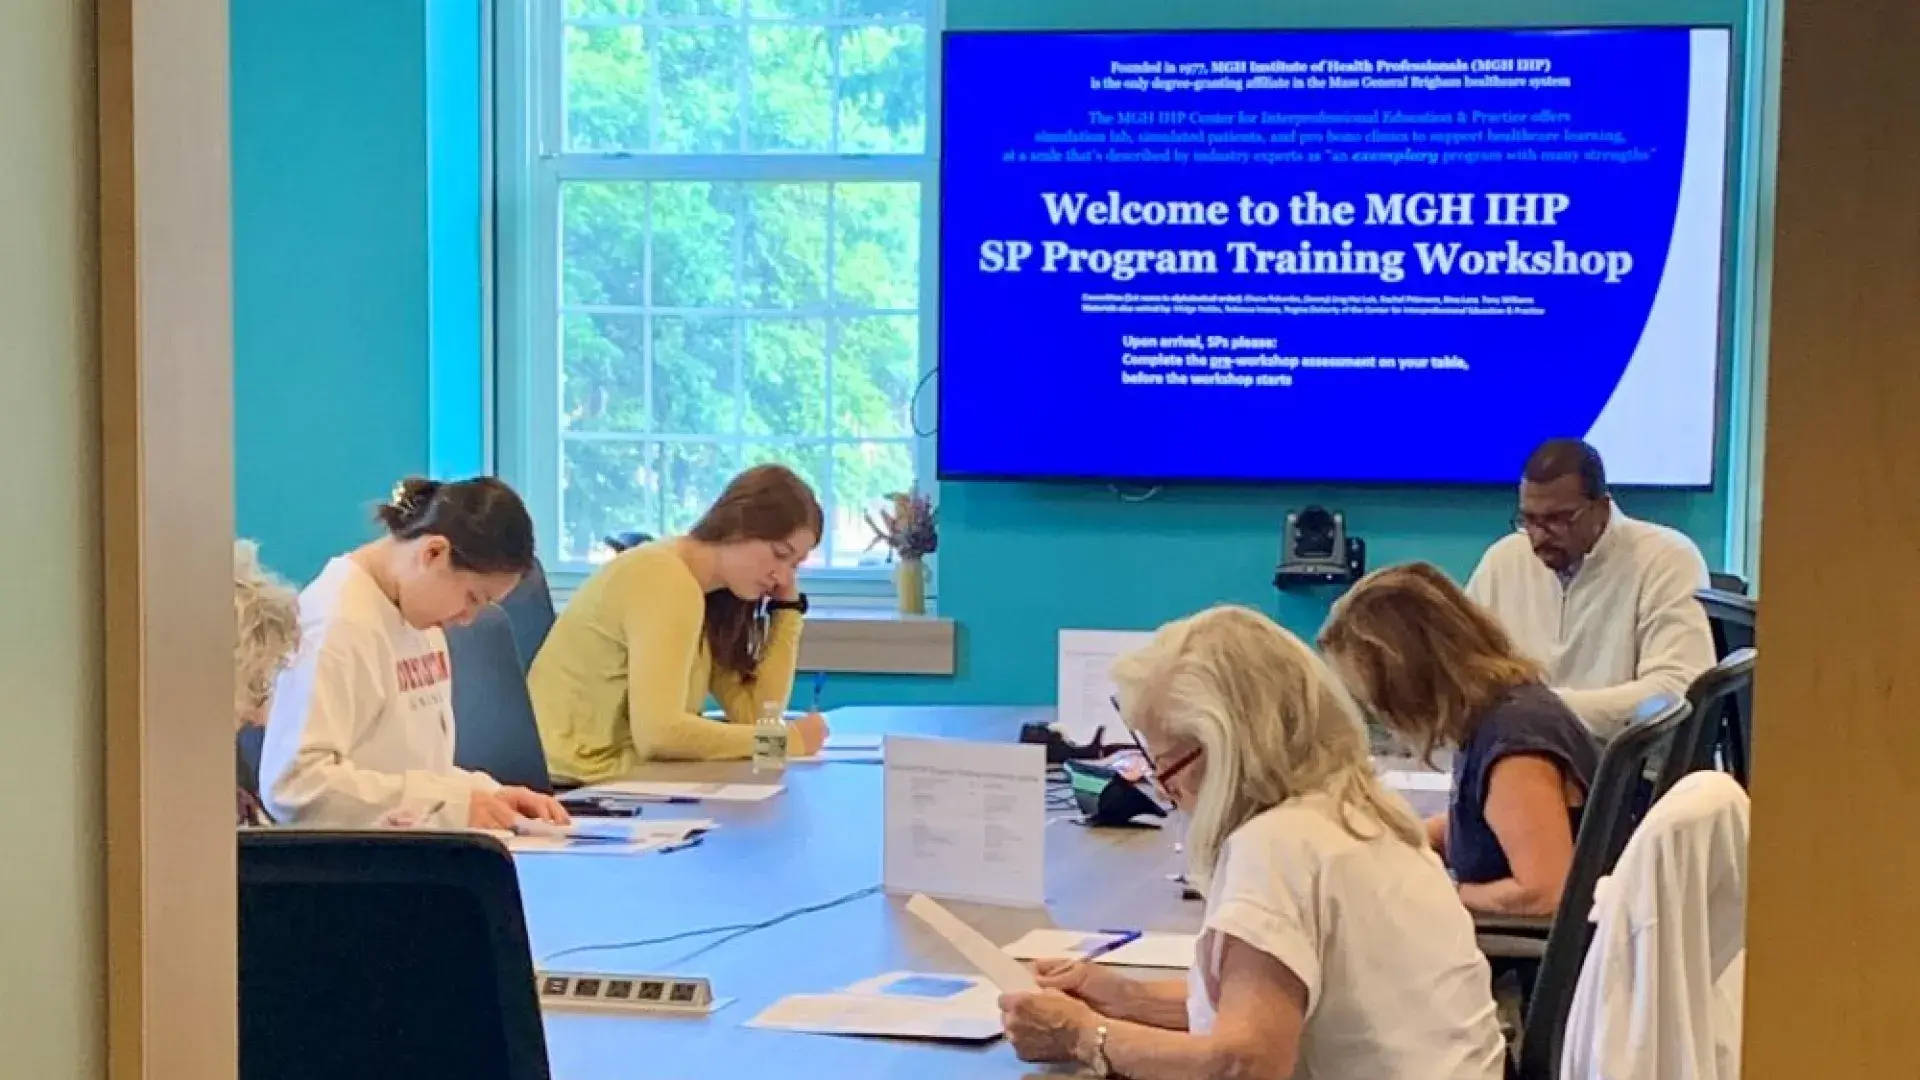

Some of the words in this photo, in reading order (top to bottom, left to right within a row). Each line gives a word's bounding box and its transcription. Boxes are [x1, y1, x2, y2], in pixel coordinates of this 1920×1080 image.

[1111, 61, 1162, 73] Founded
[1164, 61, 1177, 73] in
[1211, 60, 1247, 72] MGH
[1249, 60, 1308, 72] Institute
[1310, 60, 1327, 72] of
[1328, 60, 1373, 72] Health
[1376, 60, 1468, 72] Professionals
[1470, 59, 1513, 73] (MGH
[1516, 59, 1551, 71] IHP)
[1090, 76, 1100, 88] is
[1103, 76, 1122, 88] the
[1123, 76, 1148, 91] only
[1152, 76, 1243, 91] degree-granting
[1246, 75, 1289, 88] affiliate
[1292, 75, 1304, 88] in
[1307, 75, 1326, 88] the
[1329, 75, 1359, 87] Mass
[1361, 75, 1408, 87] General
[1411, 75, 1461, 90] Brigham
[1464, 74, 1526, 87] healthcare
[1528, 74, 1571, 90] system
[1088, 111, 1114, 123] The
[1117, 111, 1154, 123] MGH
[1158, 111, 1187, 123] IHP
[1189, 111, 1235, 123] Center
[1238, 111, 1258, 123] for
[1261, 111, 1379, 126] Interprofessional
[1382, 110, 1452, 123] Education
[1457, 110, 1467, 123] &
[1472, 110, 1527, 123] Practice
[1034, 130, 1106, 142] simulation
[1110, 130, 1133, 145] lab,
[1138, 130, 1204, 142] simulated
[1208, 130, 1266, 145] patients,
[1271, 130, 1296, 142] and
[1300, 133, 1323, 145] pro
[1365, 129, 1408, 141] clinics
[1413, 129, 1426, 141] to
[1430, 129, 1483, 144] support
[1488, 129, 1559, 141] healthcare
[1003, 149, 1015, 161] at
[1018, 152, 1028, 161] a
[1031, 149, 1062, 161] scale
[1066, 149, 1103, 161] that's
[1106, 149, 1170, 161] described
[1174, 149, 1189, 164] by
[1194, 149, 1248, 164] industry
[1253, 149, 1303, 164] experts
[1308, 152, 1321, 161] as
[1352, 148, 1438, 163] exemplary
[1443, 151, 1502, 163] program
[1507, 148, 1536, 160] with
[1541, 151, 1579, 163] many
[1041, 191, 1229, 226] Welcome
[1238, 197, 1279, 225] to
[1288, 192, 1355, 225] the
[1365, 193, 1475, 226] MGH
[1484, 193, 1570, 226] IHP
[979, 241, 1033, 272] SP
[1041, 242, 1218, 281] Program
[1227, 241, 1405, 282] Training
[1413, 241, 1633, 282] Workshop
[1122, 336, 1158, 349] Upon
[1160, 335, 1204, 350] arrival,
[1207, 336, 1229, 348] SPs
[1231, 336, 1277, 349] please:
[1122, 354, 1183, 368] Complete
[1185, 353, 1207, 367] the
[1209, 354, 1299, 369] pre-workshop
[1301, 357, 1376, 367] assessment
[1378, 357, 1396, 367] on
[1398, 358, 1429, 370] your
[1430, 355, 1469, 370] table,
[1121, 371, 1164, 384] before
[1165, 372, 1188, 384] the
[1190, 372, 1254, 387] workshop
[1256, 374, 1292, 385] starts
